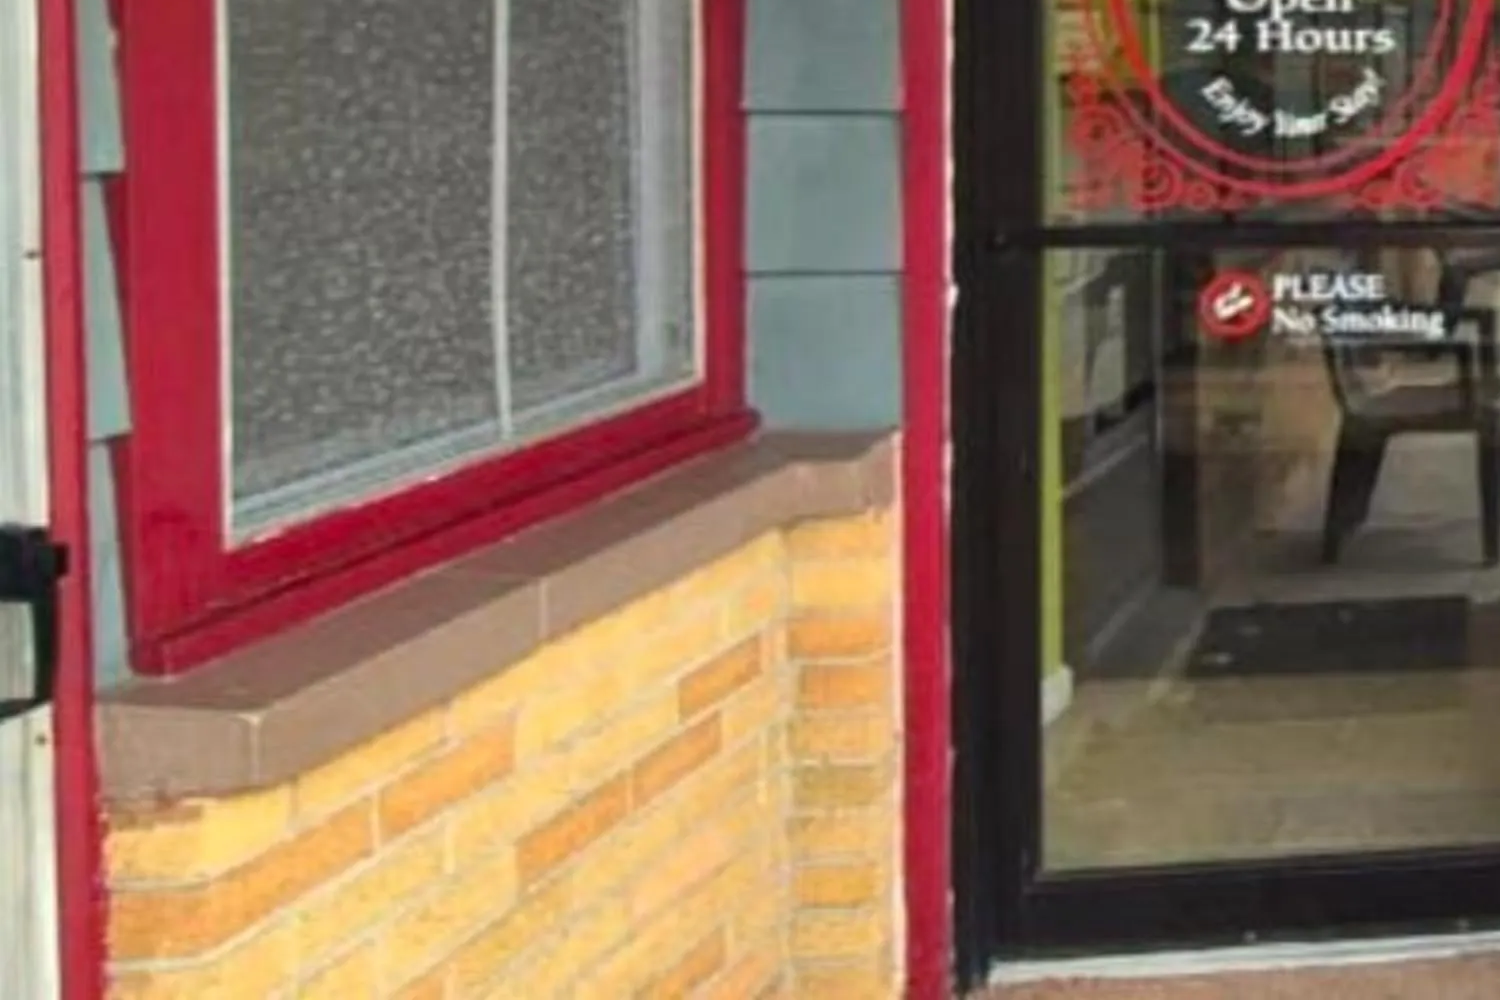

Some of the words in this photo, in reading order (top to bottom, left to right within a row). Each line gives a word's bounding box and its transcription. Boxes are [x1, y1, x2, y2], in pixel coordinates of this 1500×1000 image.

[1186, 18, 1242, 51] 24
[1255, 18, 1396, 51] Hours
[1273, 273, 1384, 299] PLEASE
[1272, 307, 1316, 333] No
[1322, 304, 1445, 341] Smoking
